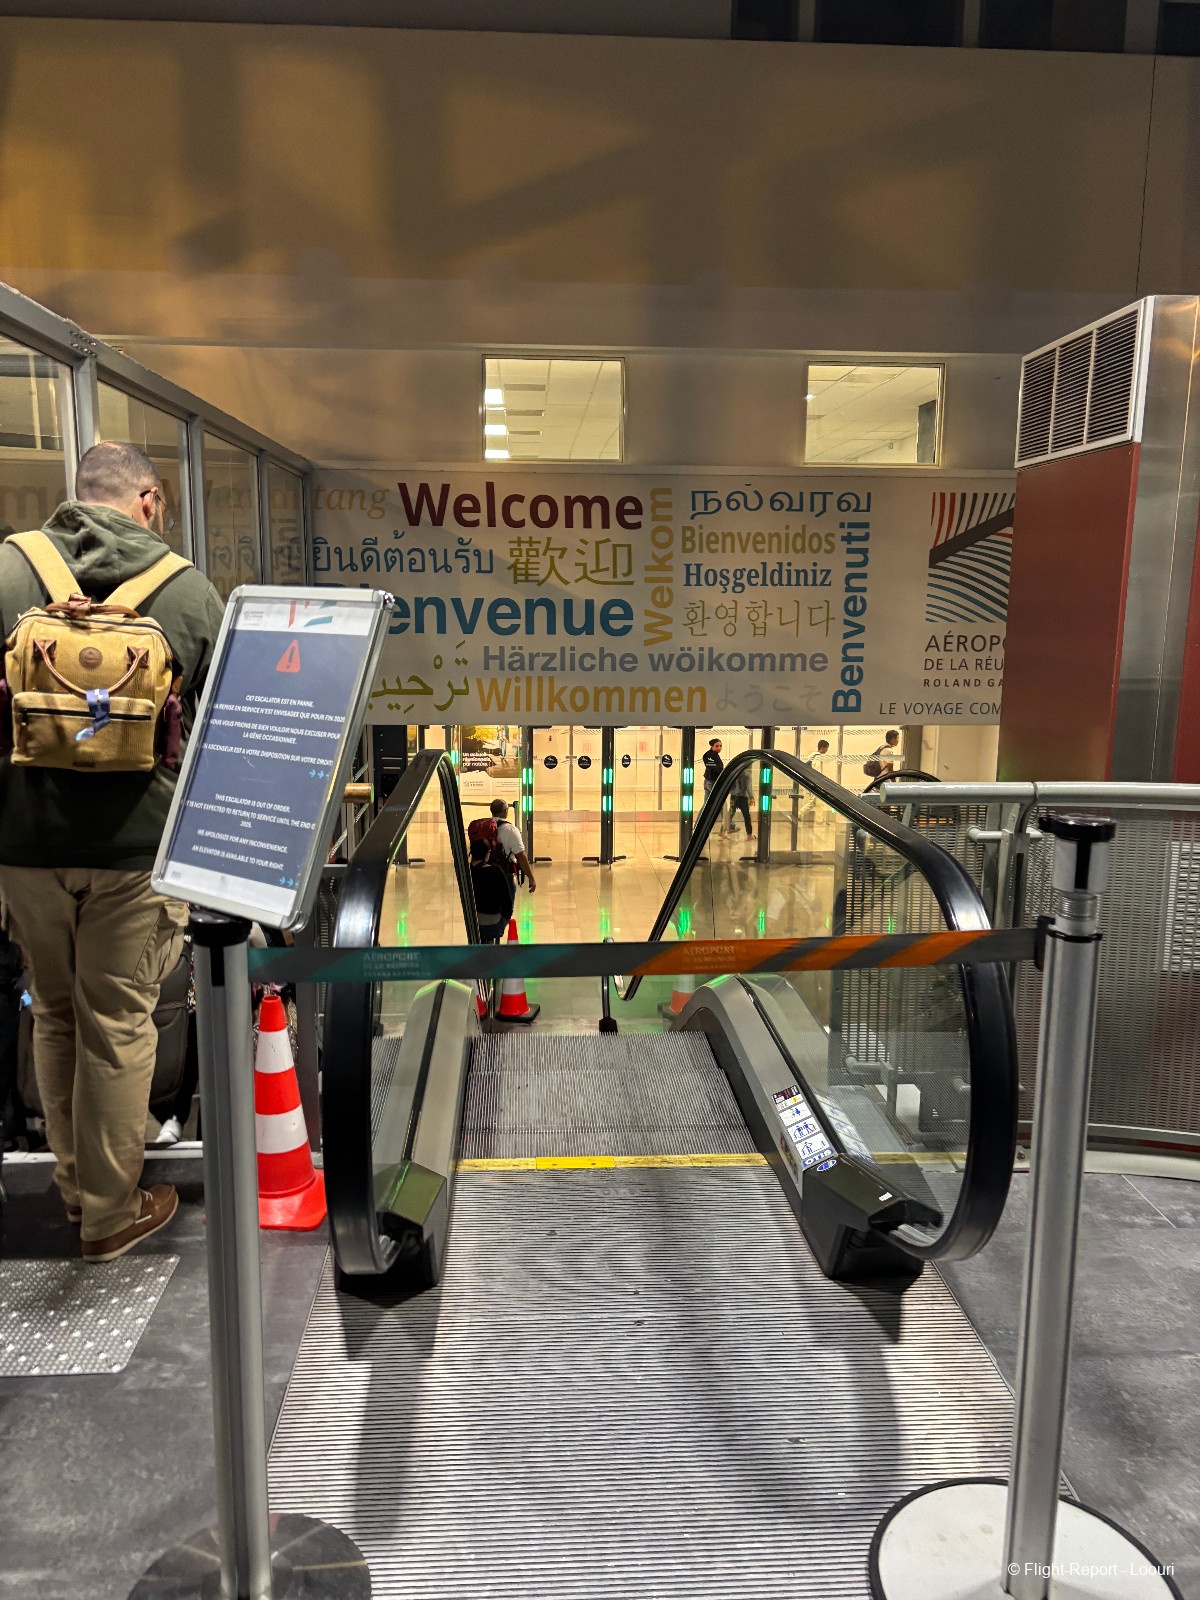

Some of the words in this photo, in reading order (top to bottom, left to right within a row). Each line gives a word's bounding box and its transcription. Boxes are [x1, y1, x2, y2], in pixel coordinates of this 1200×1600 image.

[398, 482, 643, 529] Welcome
[681, 524, 836, 554] Bienvenidos
[507, 536, 635, 587] 歡迎
[644, 487, 674, 646] Welkom
[684, 562, 832, 593] Hoşgeldiniz
[682, 600, 836, 637] 환영합니다
[831, 521, 871, 713] Benvenuti
[925, 631, 1005, 653] AÉROP
[483, 646, 638, 672] Härzliche
[648, 647, 829, 673] wöikomme
[924, 658, 944, 671] DE
[950, 658, 969, 671] LA
[476, 675, 707, 713] Willkommen
[924, 678, 981, 688] ROLAND
[255, 695, 280, 703] ESCALATOR
[716, 684, 822, 713] ようこそ
[880, 702, 897, 715] LE
[904, 702, 963, 715] VOYAGE
[261, 751, 290, 759] DISPOSITION
[225, 796, 251, 805] ESCALATOR
[203, 804, 225, 812] EXPECTED
[232, 809, 249, 817] RETURN
[257, 814, 276, 822] SERVICE
[205, 830, 229, 840] APOLOGIZE
[199, 846, 220, 855] ELEVATOR
[226, 851, 248, 861] AVAILABLE
